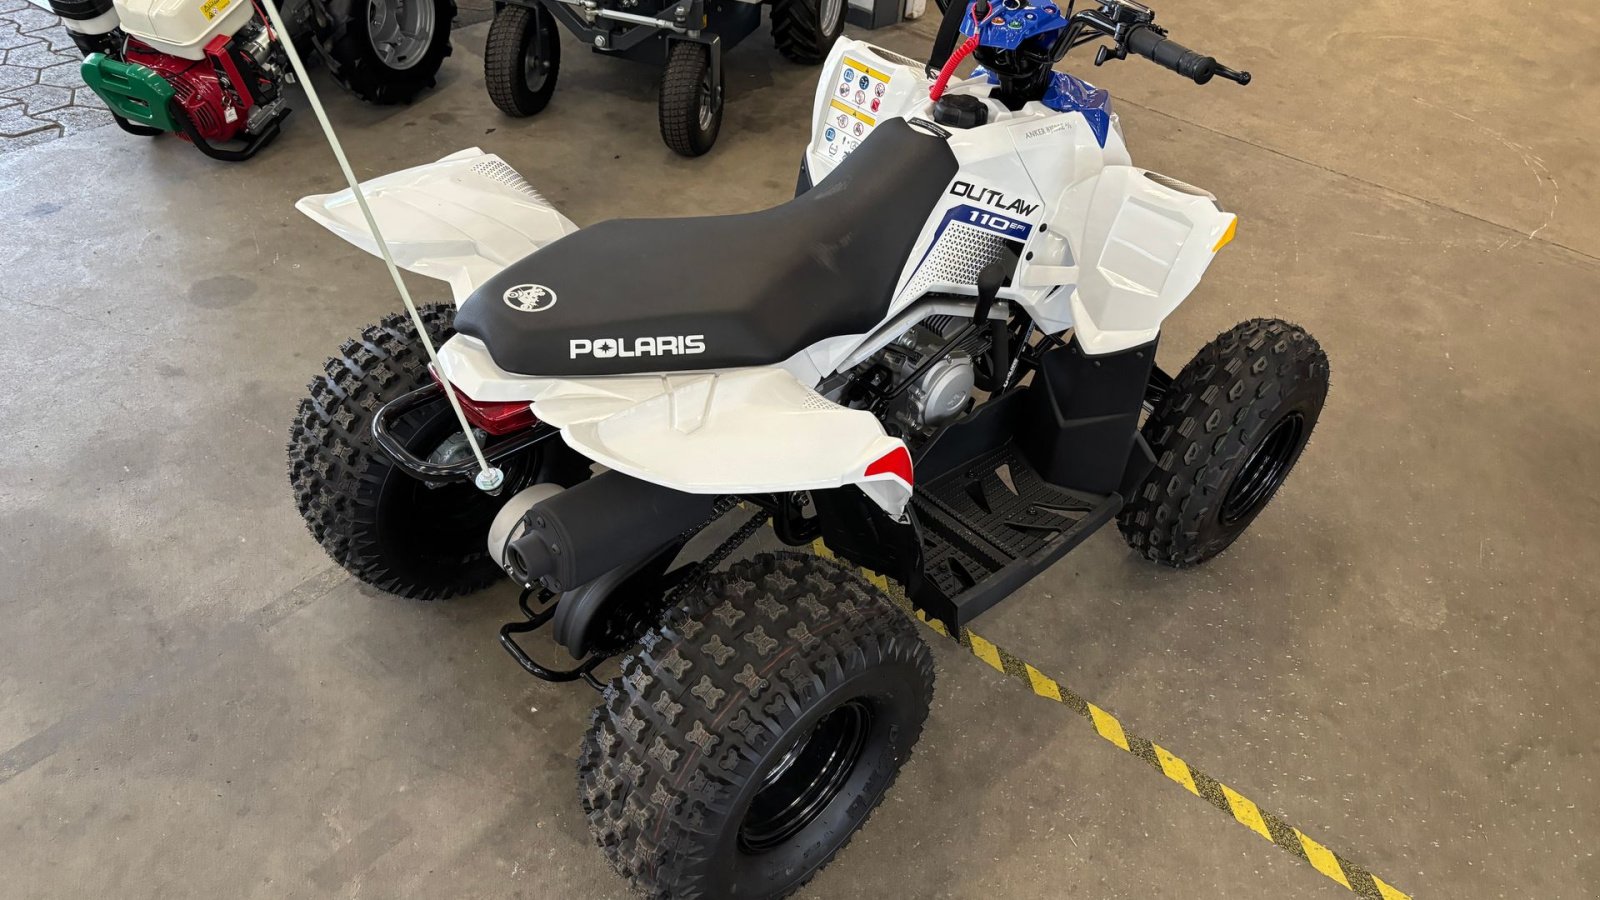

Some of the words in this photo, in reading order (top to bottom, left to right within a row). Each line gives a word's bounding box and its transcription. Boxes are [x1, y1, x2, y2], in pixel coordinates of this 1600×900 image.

[949, 180, 1039, 216] OUTLAW
[969, 210, 1010, 231] 110
[569, 334, 705, 359] POLARIS
